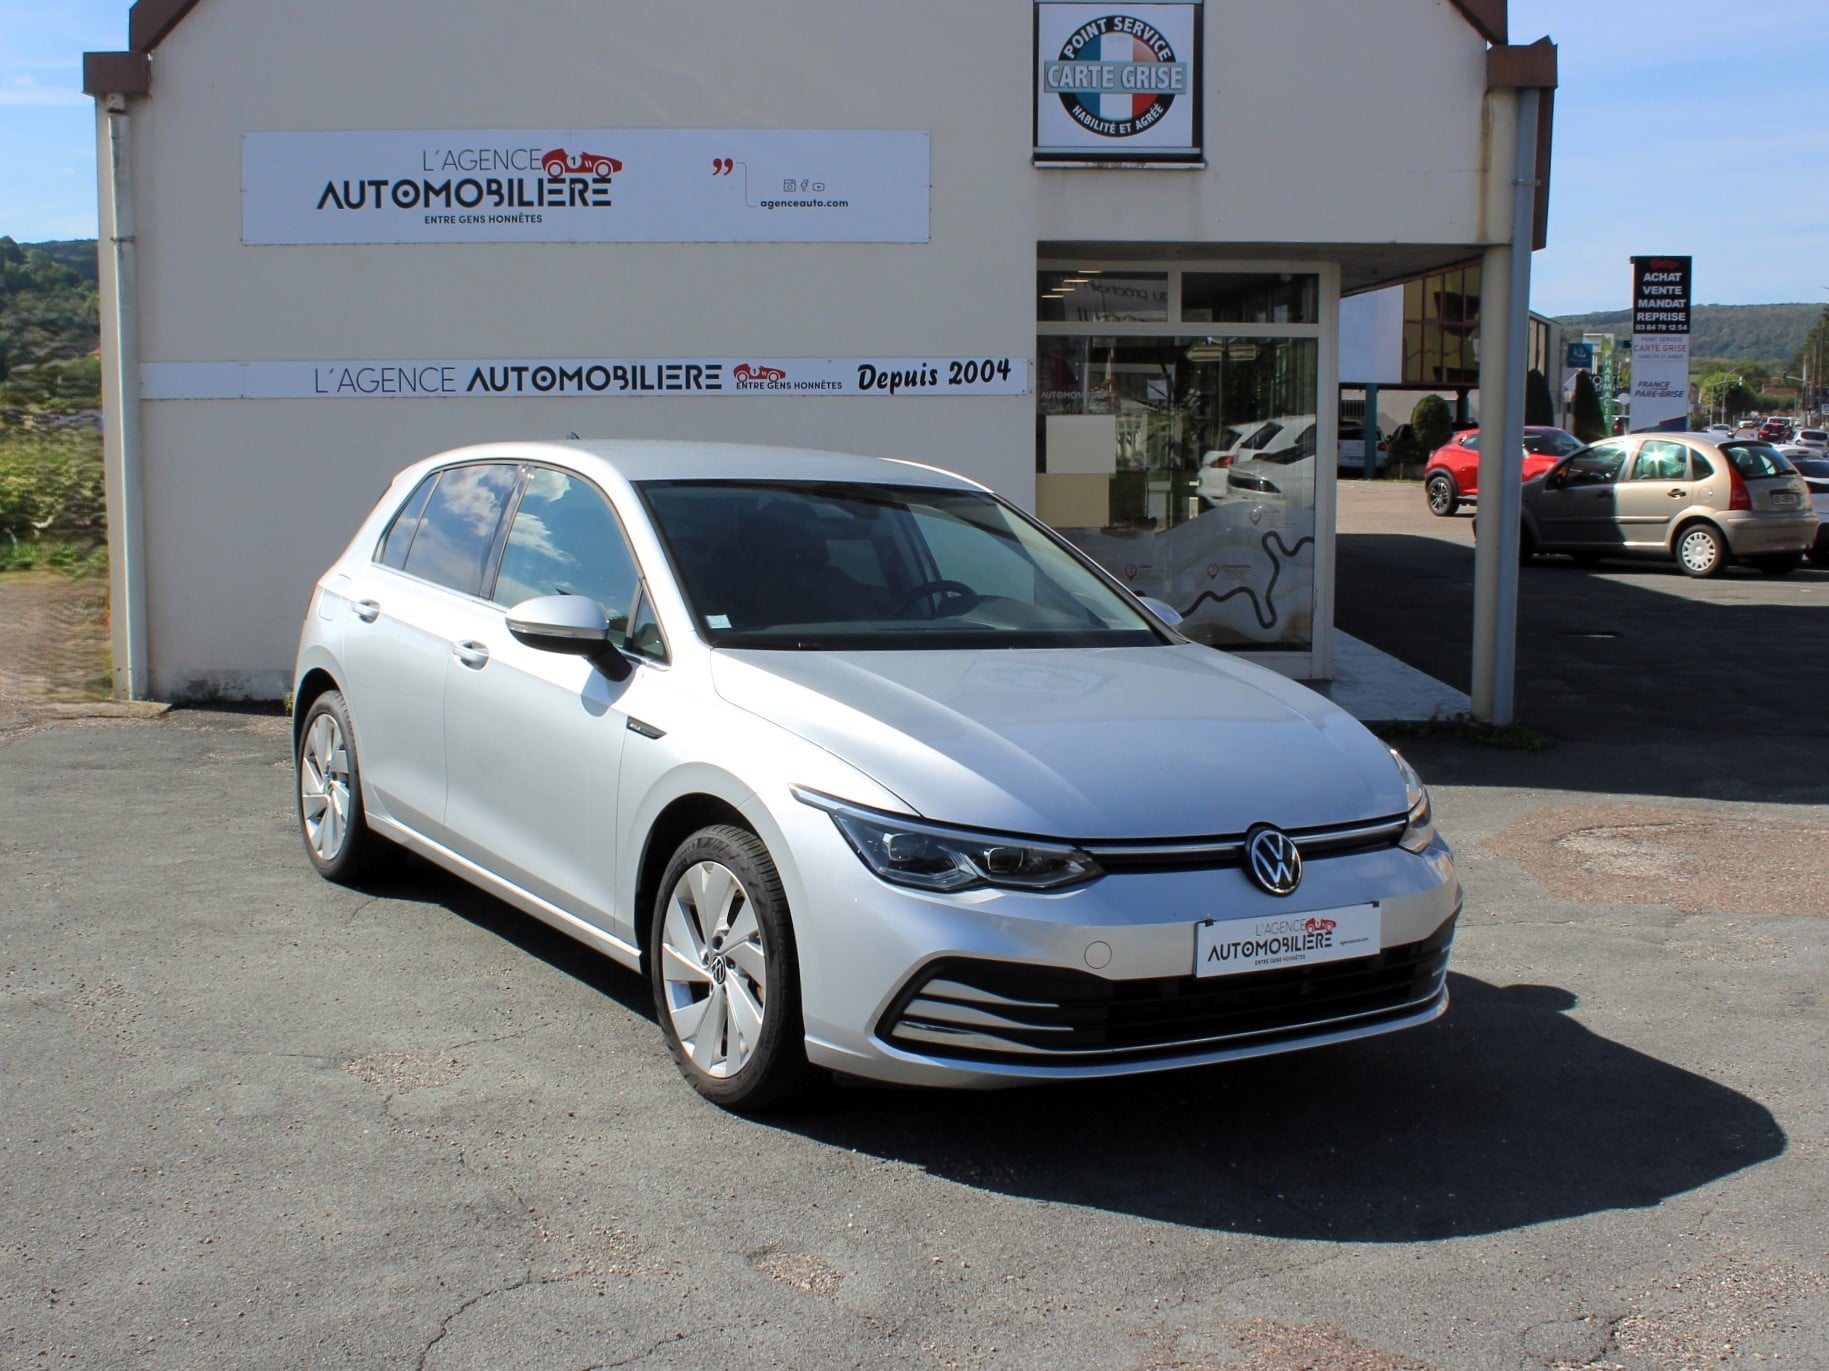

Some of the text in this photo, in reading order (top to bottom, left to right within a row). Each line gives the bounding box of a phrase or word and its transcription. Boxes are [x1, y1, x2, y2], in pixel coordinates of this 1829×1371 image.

[1063, 17, 1172, 62] POINT SERVICE
[1047, 65, 1183, 90] CARTE GRISE
[1072, 103, 1164, 134] HABILITÉ ET AGRÉÉ
[423, 149, 542, 171] L'AGENCE
[760, 199, 849, 209] agenceauto.com
[424, 212, 543, 225] ENTRE GENS HONNÊTES
[1643, 272, 1682, 282] ACHAT
[1643, 286, 1682, 295] VENTE
[1638, 299, 1687, 308] MANDAT
[1637, 312, 1686, 321] REPRISE
[1633, 344, 1660, 352] CARTE
[314, 366, 456, 394] L'AGENCE
[857, 358, 1012, 394] Depuis 2004
[736, 379, 842, 390] ENTRE GENS HONNÊTES
[1634, 390, 1685, 398] PARE-BRISE
[1255, 918, 1306, 937] L'AGENCE
